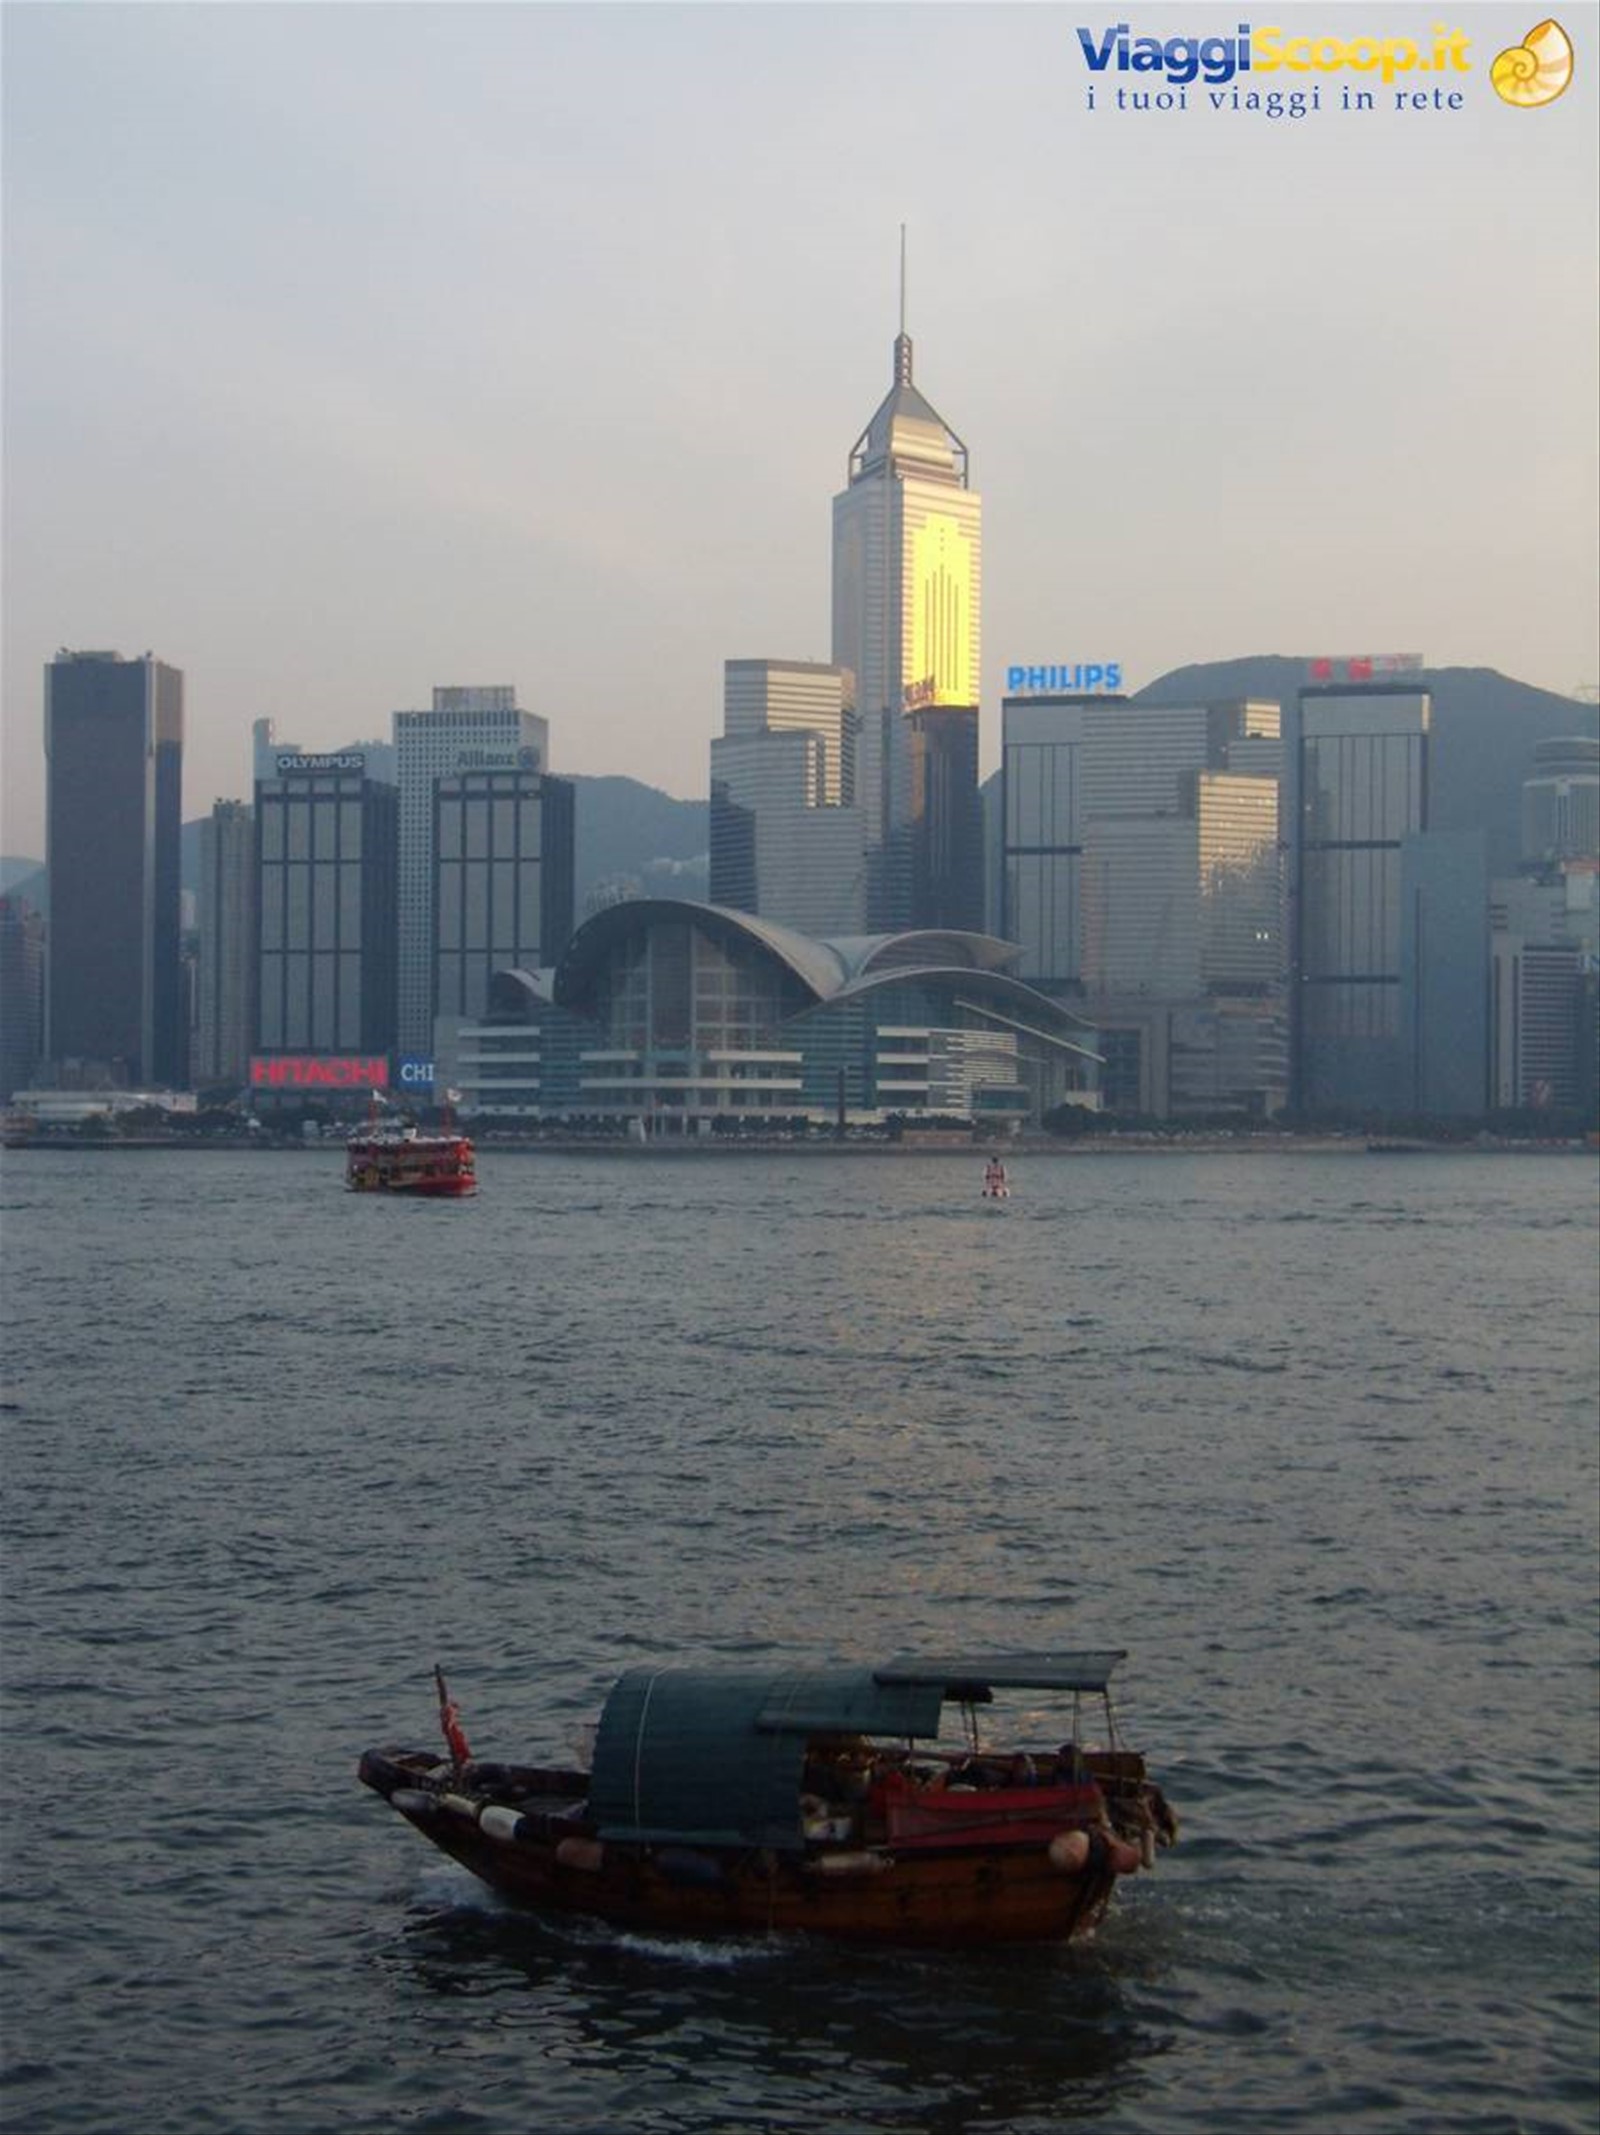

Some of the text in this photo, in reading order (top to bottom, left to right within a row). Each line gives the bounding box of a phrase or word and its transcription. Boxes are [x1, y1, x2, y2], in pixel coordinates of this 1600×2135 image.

[1008, 663, 1121, 690] PHILIPS
[278, 755, 364, 769] OLYMPUS
[457, 749, 516, 768] Allianz
[253, 1059, 388, 1084] HITACHI
